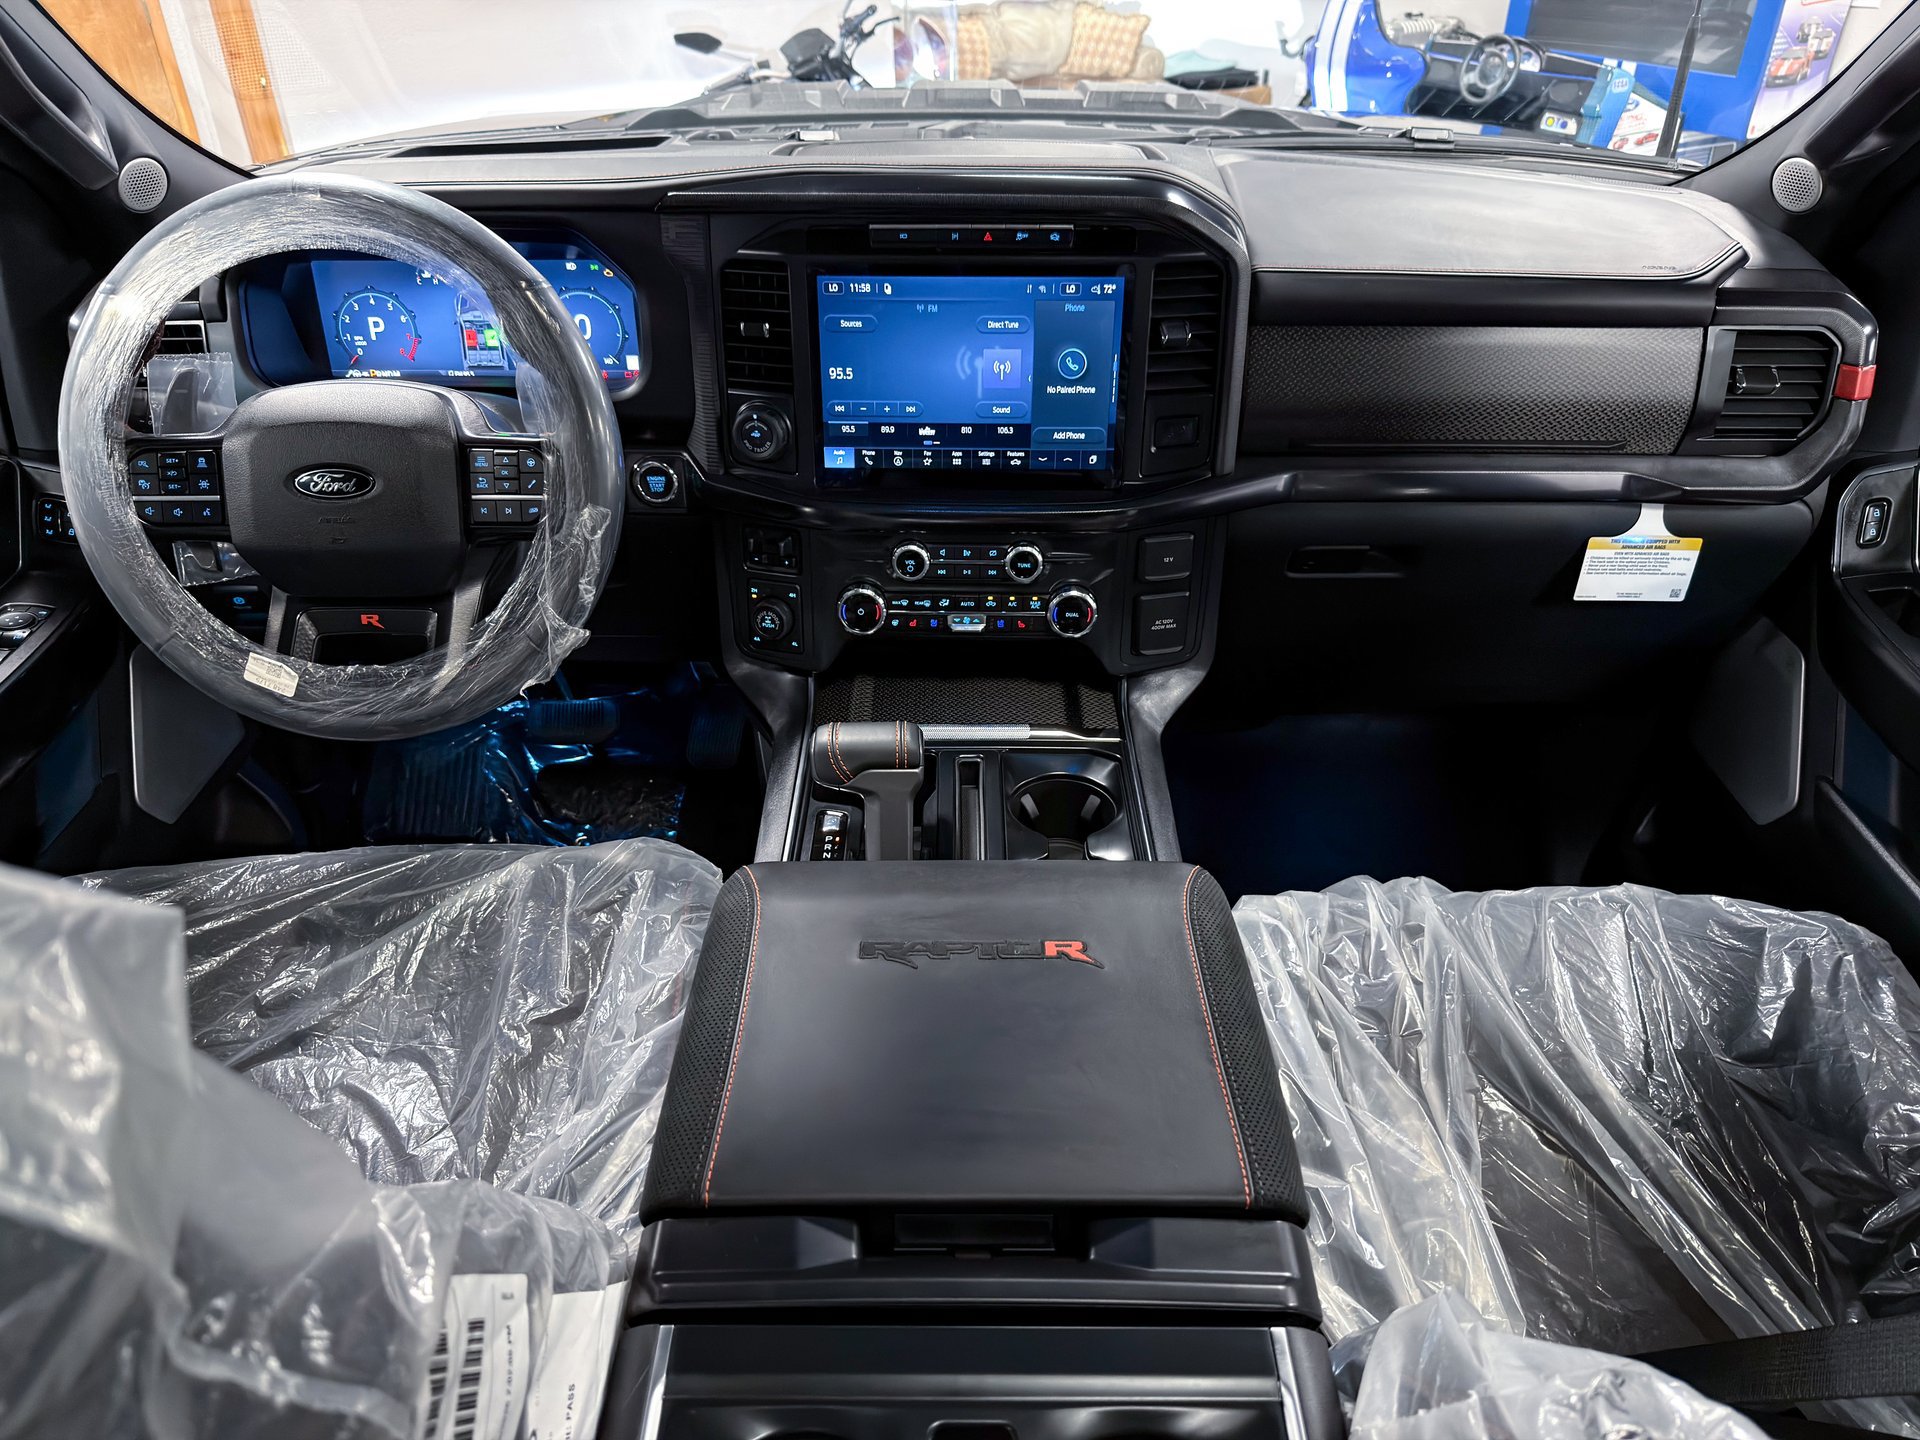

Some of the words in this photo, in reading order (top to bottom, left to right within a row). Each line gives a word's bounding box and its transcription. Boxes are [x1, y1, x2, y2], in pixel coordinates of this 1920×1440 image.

[828, 284, 838, 292] LO
[850, 283, 870, 292] 11:58
[1066, 284, 1075, 293] LO
[928, 304, 938, 312] FM
[1064, 303, 1086, 312] Phone
[367, 317, 385, 340] P
[840, 320, 862, 328] Sources
[829, 367, 853, 379] 95.5
[1057, 386, 1075, 394] Paired
[1076, 386, 1095, 394] Phone
[310, 473, 357, 492] Ford
[361, 614, 385, 628] R
[860, 940, 1105, 969] RAPTOR
[565, 1383, 576, 1421] PASS
